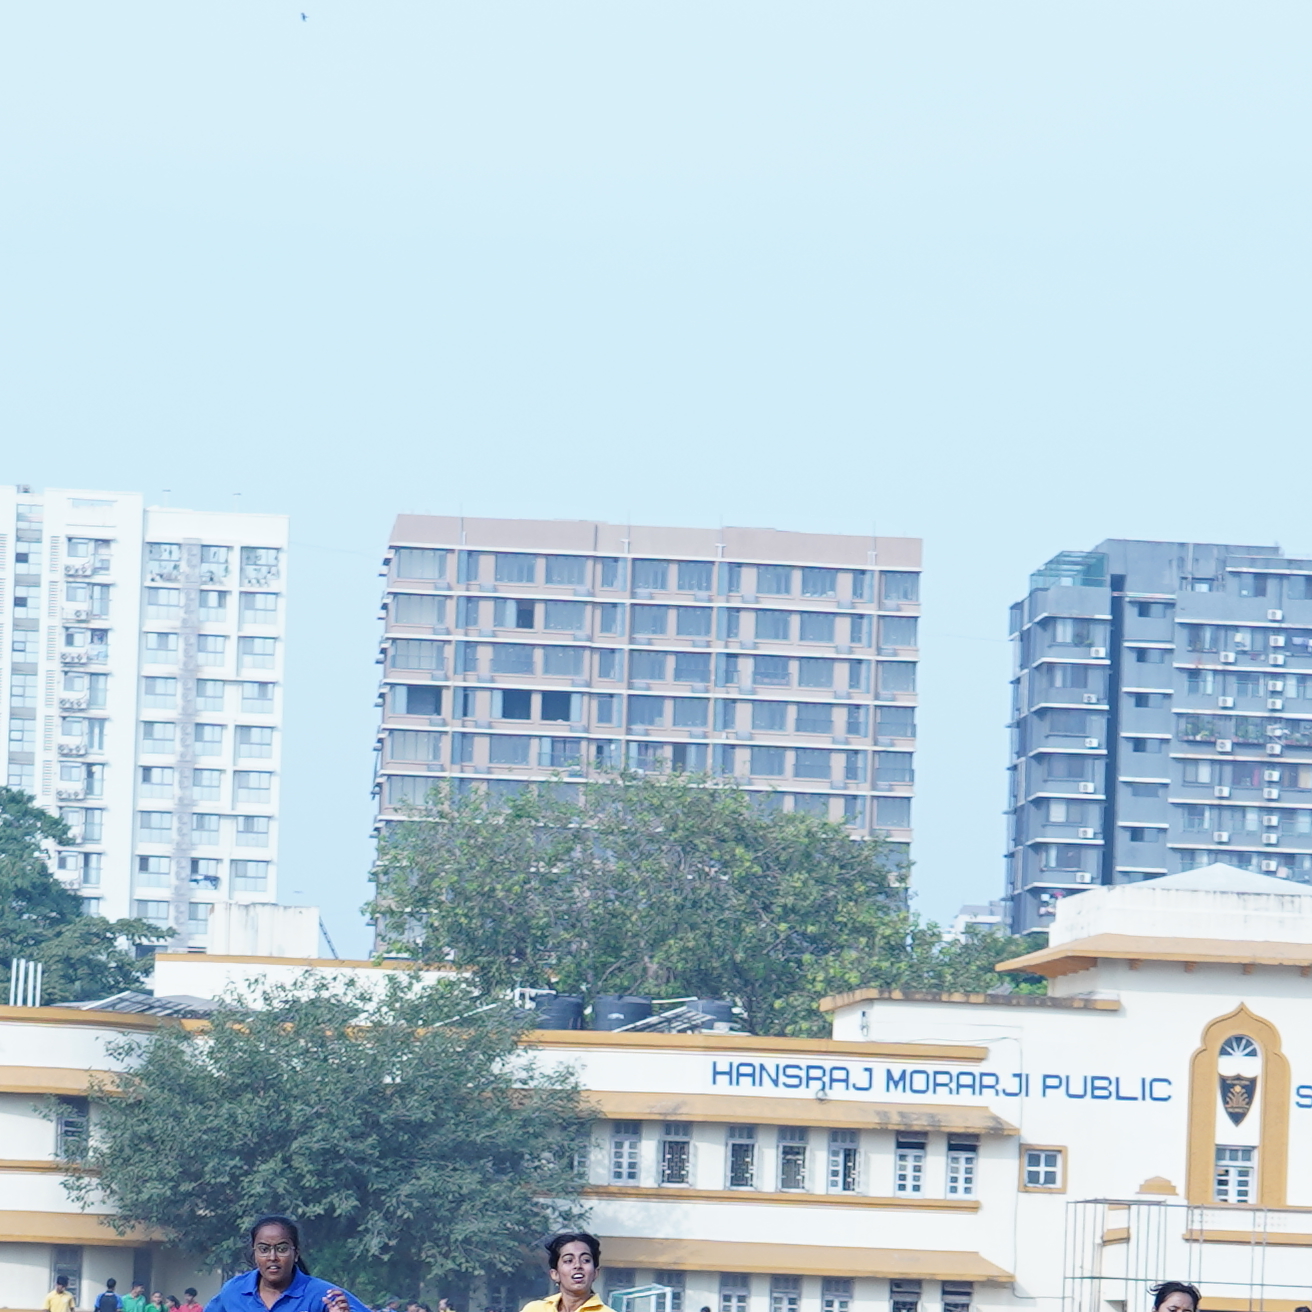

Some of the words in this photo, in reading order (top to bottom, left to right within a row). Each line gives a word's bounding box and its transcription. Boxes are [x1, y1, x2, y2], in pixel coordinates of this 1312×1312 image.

[712, 1062, 872, 1091] HANSRAJ
[885, 1069, 1029, 1097] MORARJI
[1042, 1075, 1172, 1102] PUBLIC
